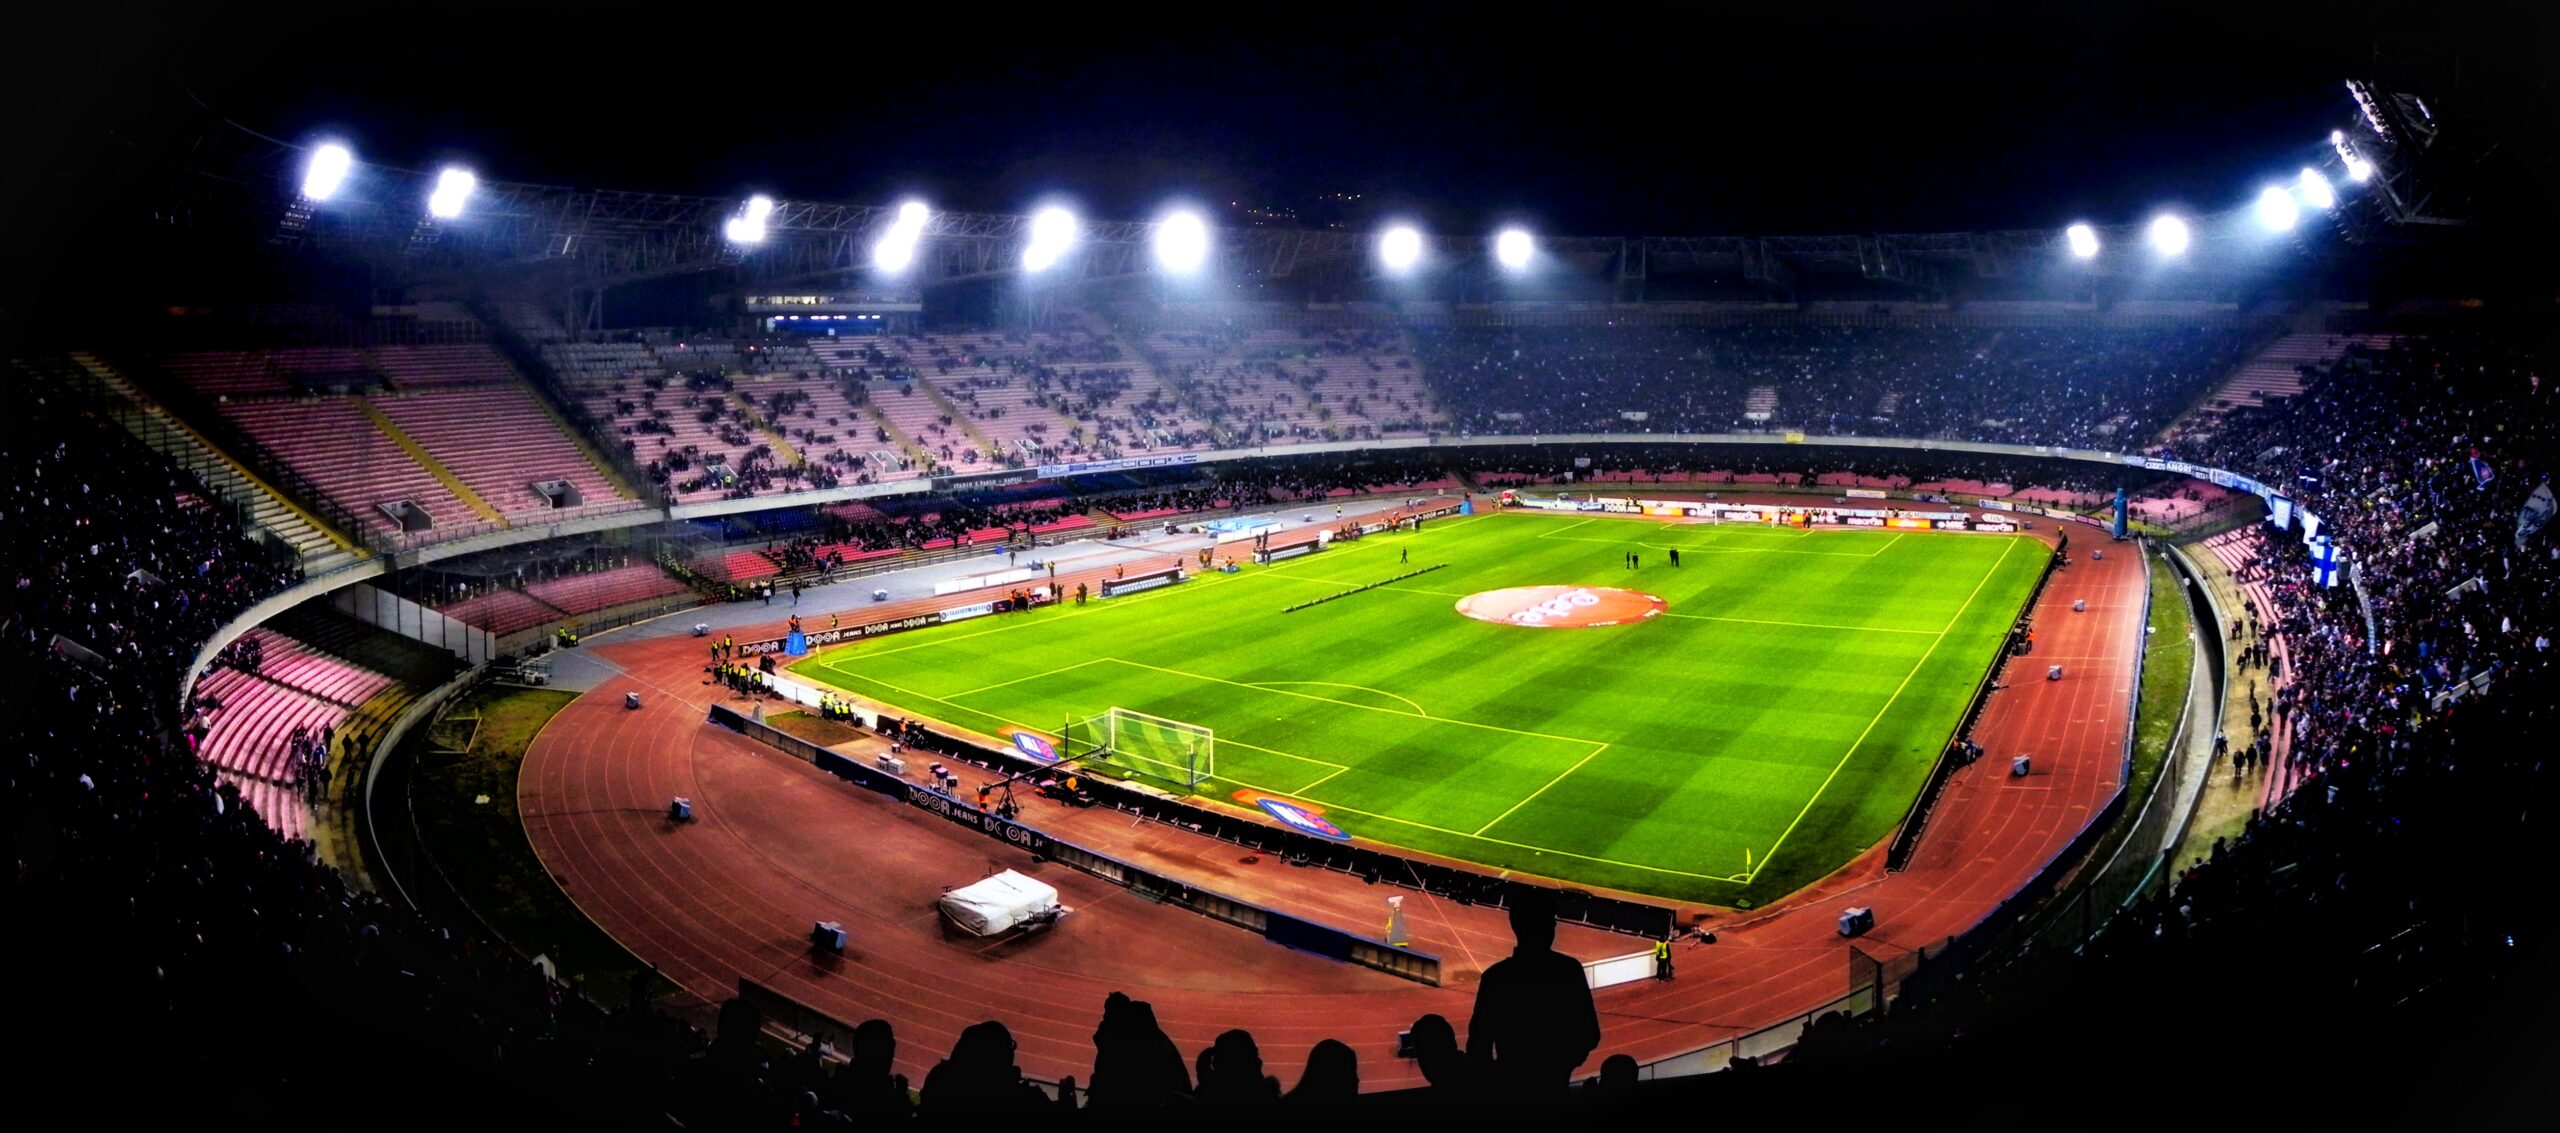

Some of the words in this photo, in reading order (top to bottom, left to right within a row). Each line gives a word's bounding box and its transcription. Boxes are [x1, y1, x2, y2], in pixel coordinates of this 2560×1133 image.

[806, 631, 840, 646] DOOA
[865, 622, 888, 635] DOOA
[908, 786, 951, 816] DOOA
